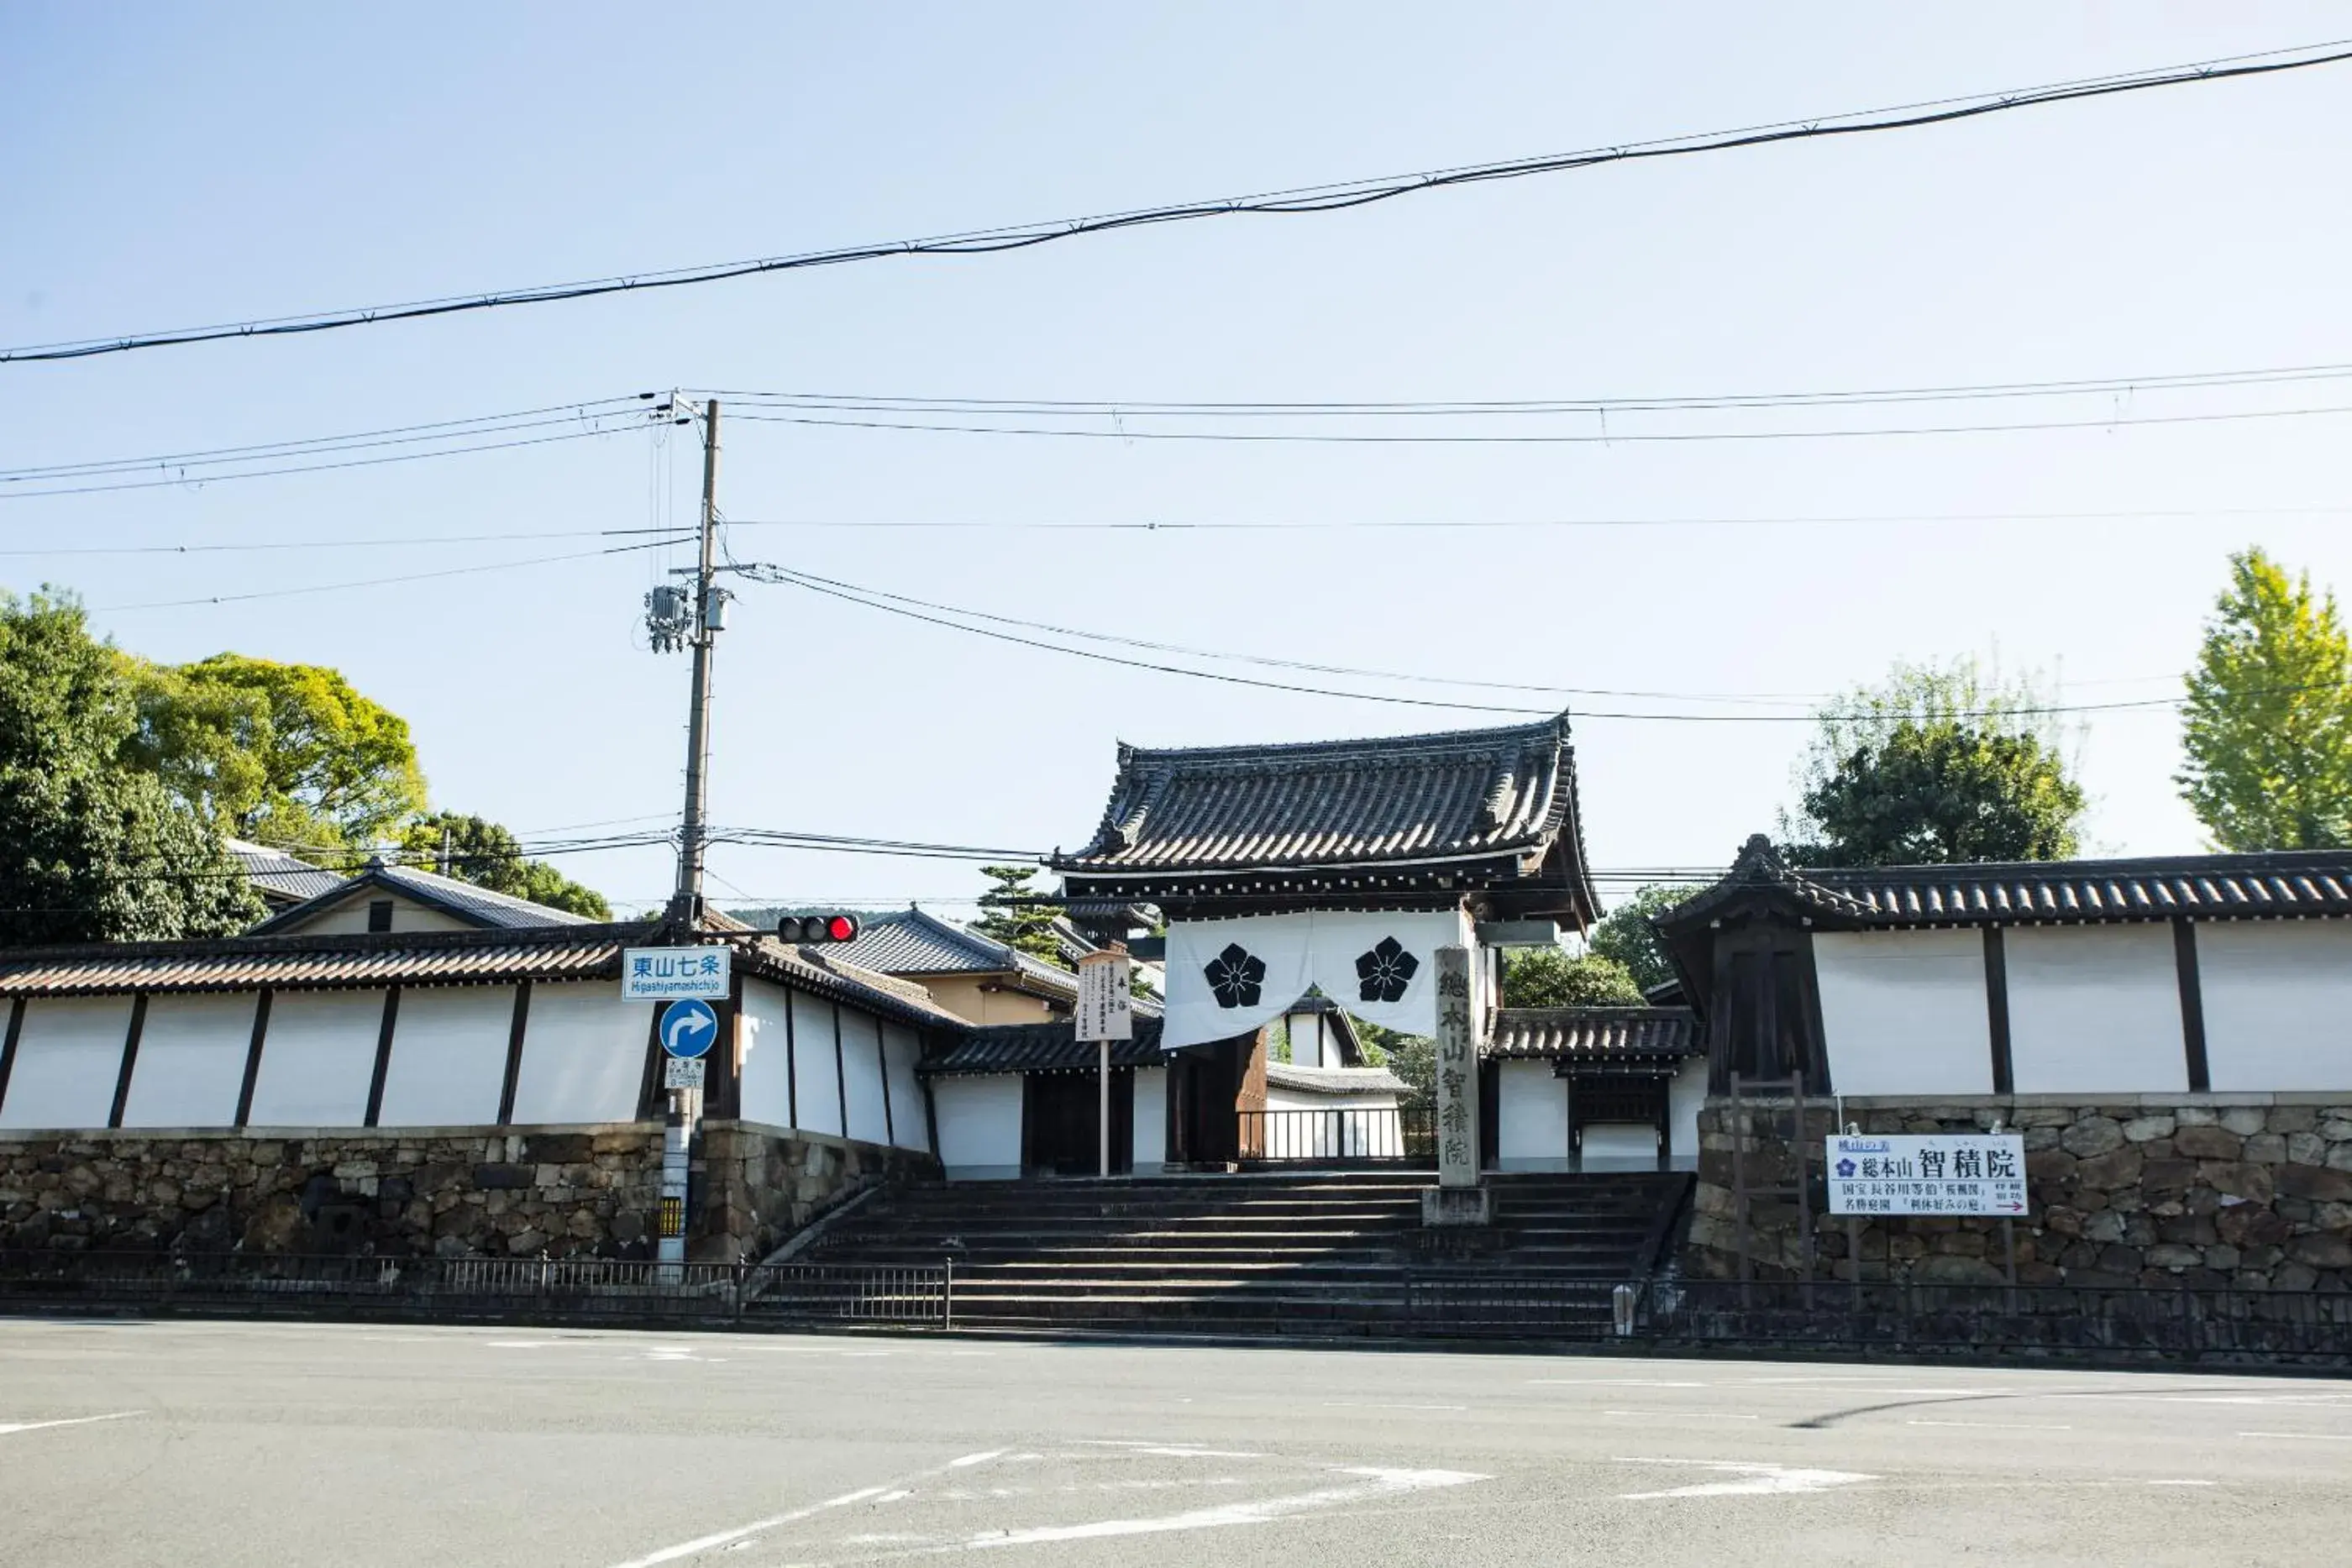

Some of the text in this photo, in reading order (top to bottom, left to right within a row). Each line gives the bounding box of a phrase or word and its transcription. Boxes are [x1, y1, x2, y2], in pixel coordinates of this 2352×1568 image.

[633, 954, 720, 978] 東山七条
[631, 979, 720, 994] Higashiyamashichijo
[1862, 1149, 2016, 1178] 総本山 智積院
